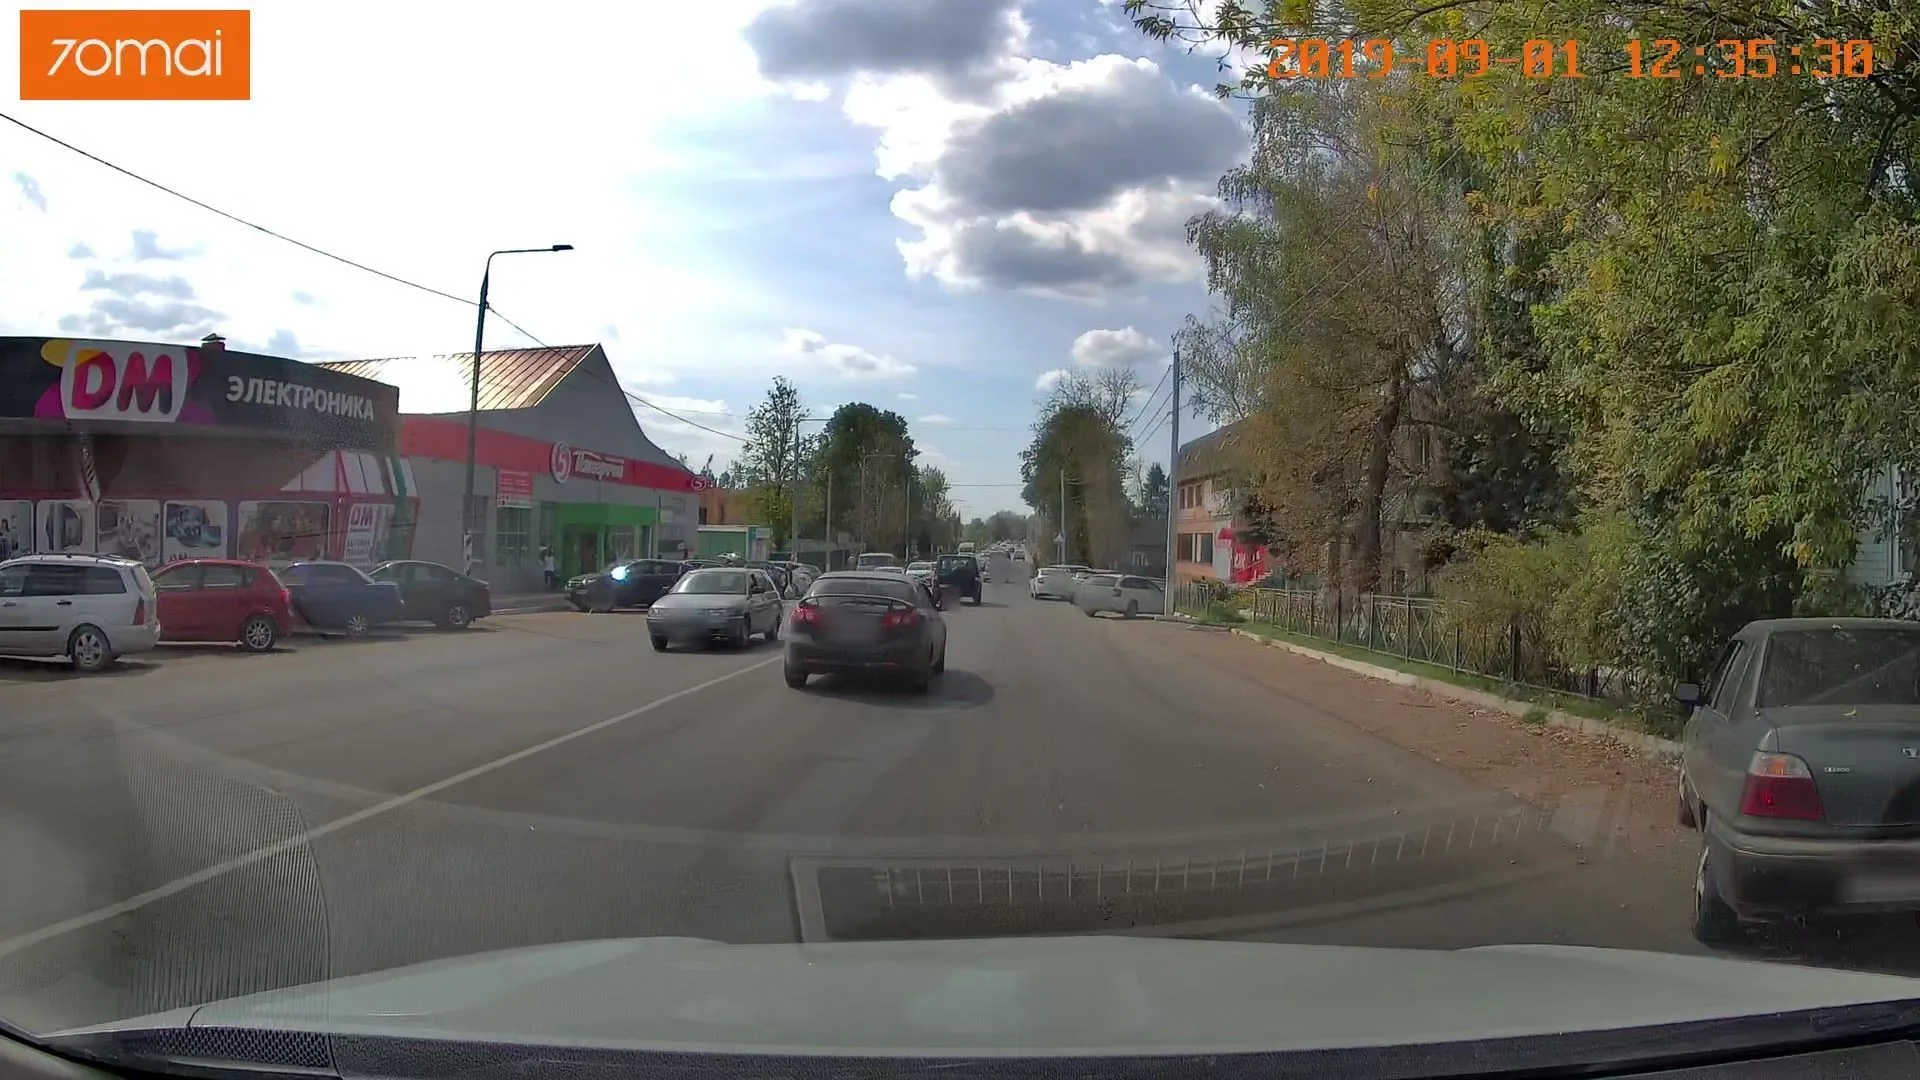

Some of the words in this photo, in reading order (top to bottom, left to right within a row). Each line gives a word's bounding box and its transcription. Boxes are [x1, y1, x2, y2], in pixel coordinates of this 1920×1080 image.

[71, 350, 173, 415] DM
[225, 375, 375, 421] ЭЛЕКТРОНИКА
[350, 506, 373, 526] DM
